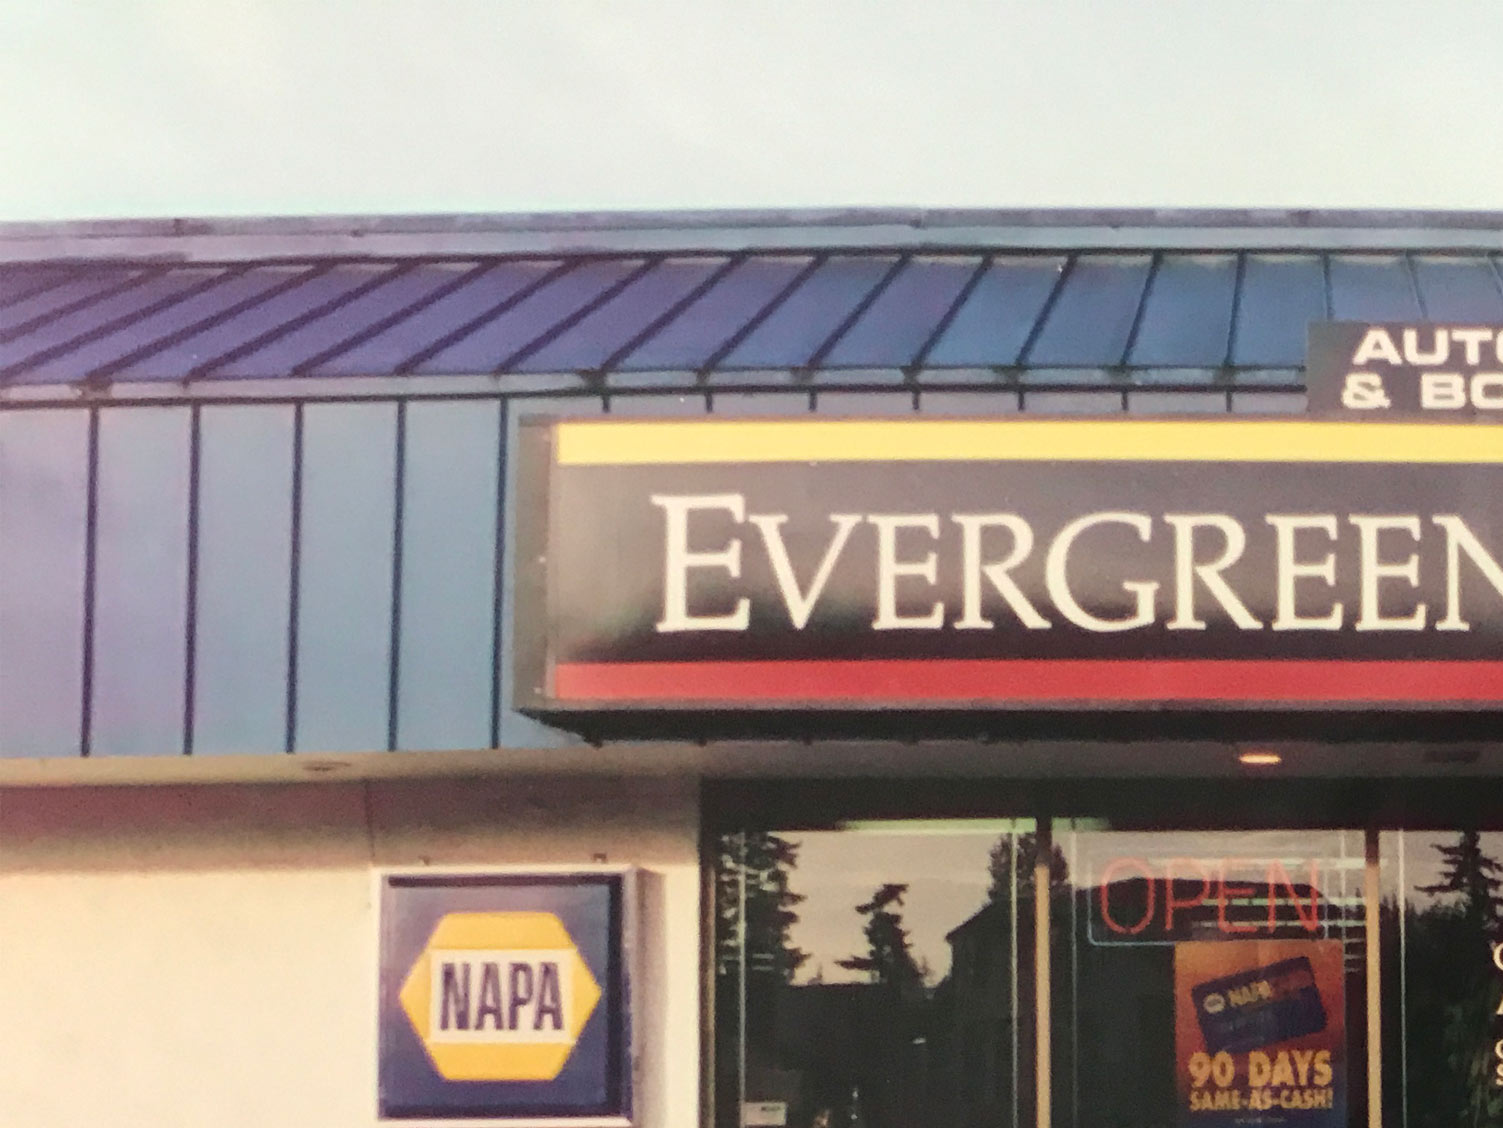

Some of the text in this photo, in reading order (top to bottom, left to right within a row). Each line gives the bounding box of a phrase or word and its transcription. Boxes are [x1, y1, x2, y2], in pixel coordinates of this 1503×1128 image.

[1341, 372, 1391, 410] &
[1100, 856, 1319, 935] OPEN
[440, 961, 565, 1031] NAPA
[1188, 1050, 1334, 1088] 90 DAYS
